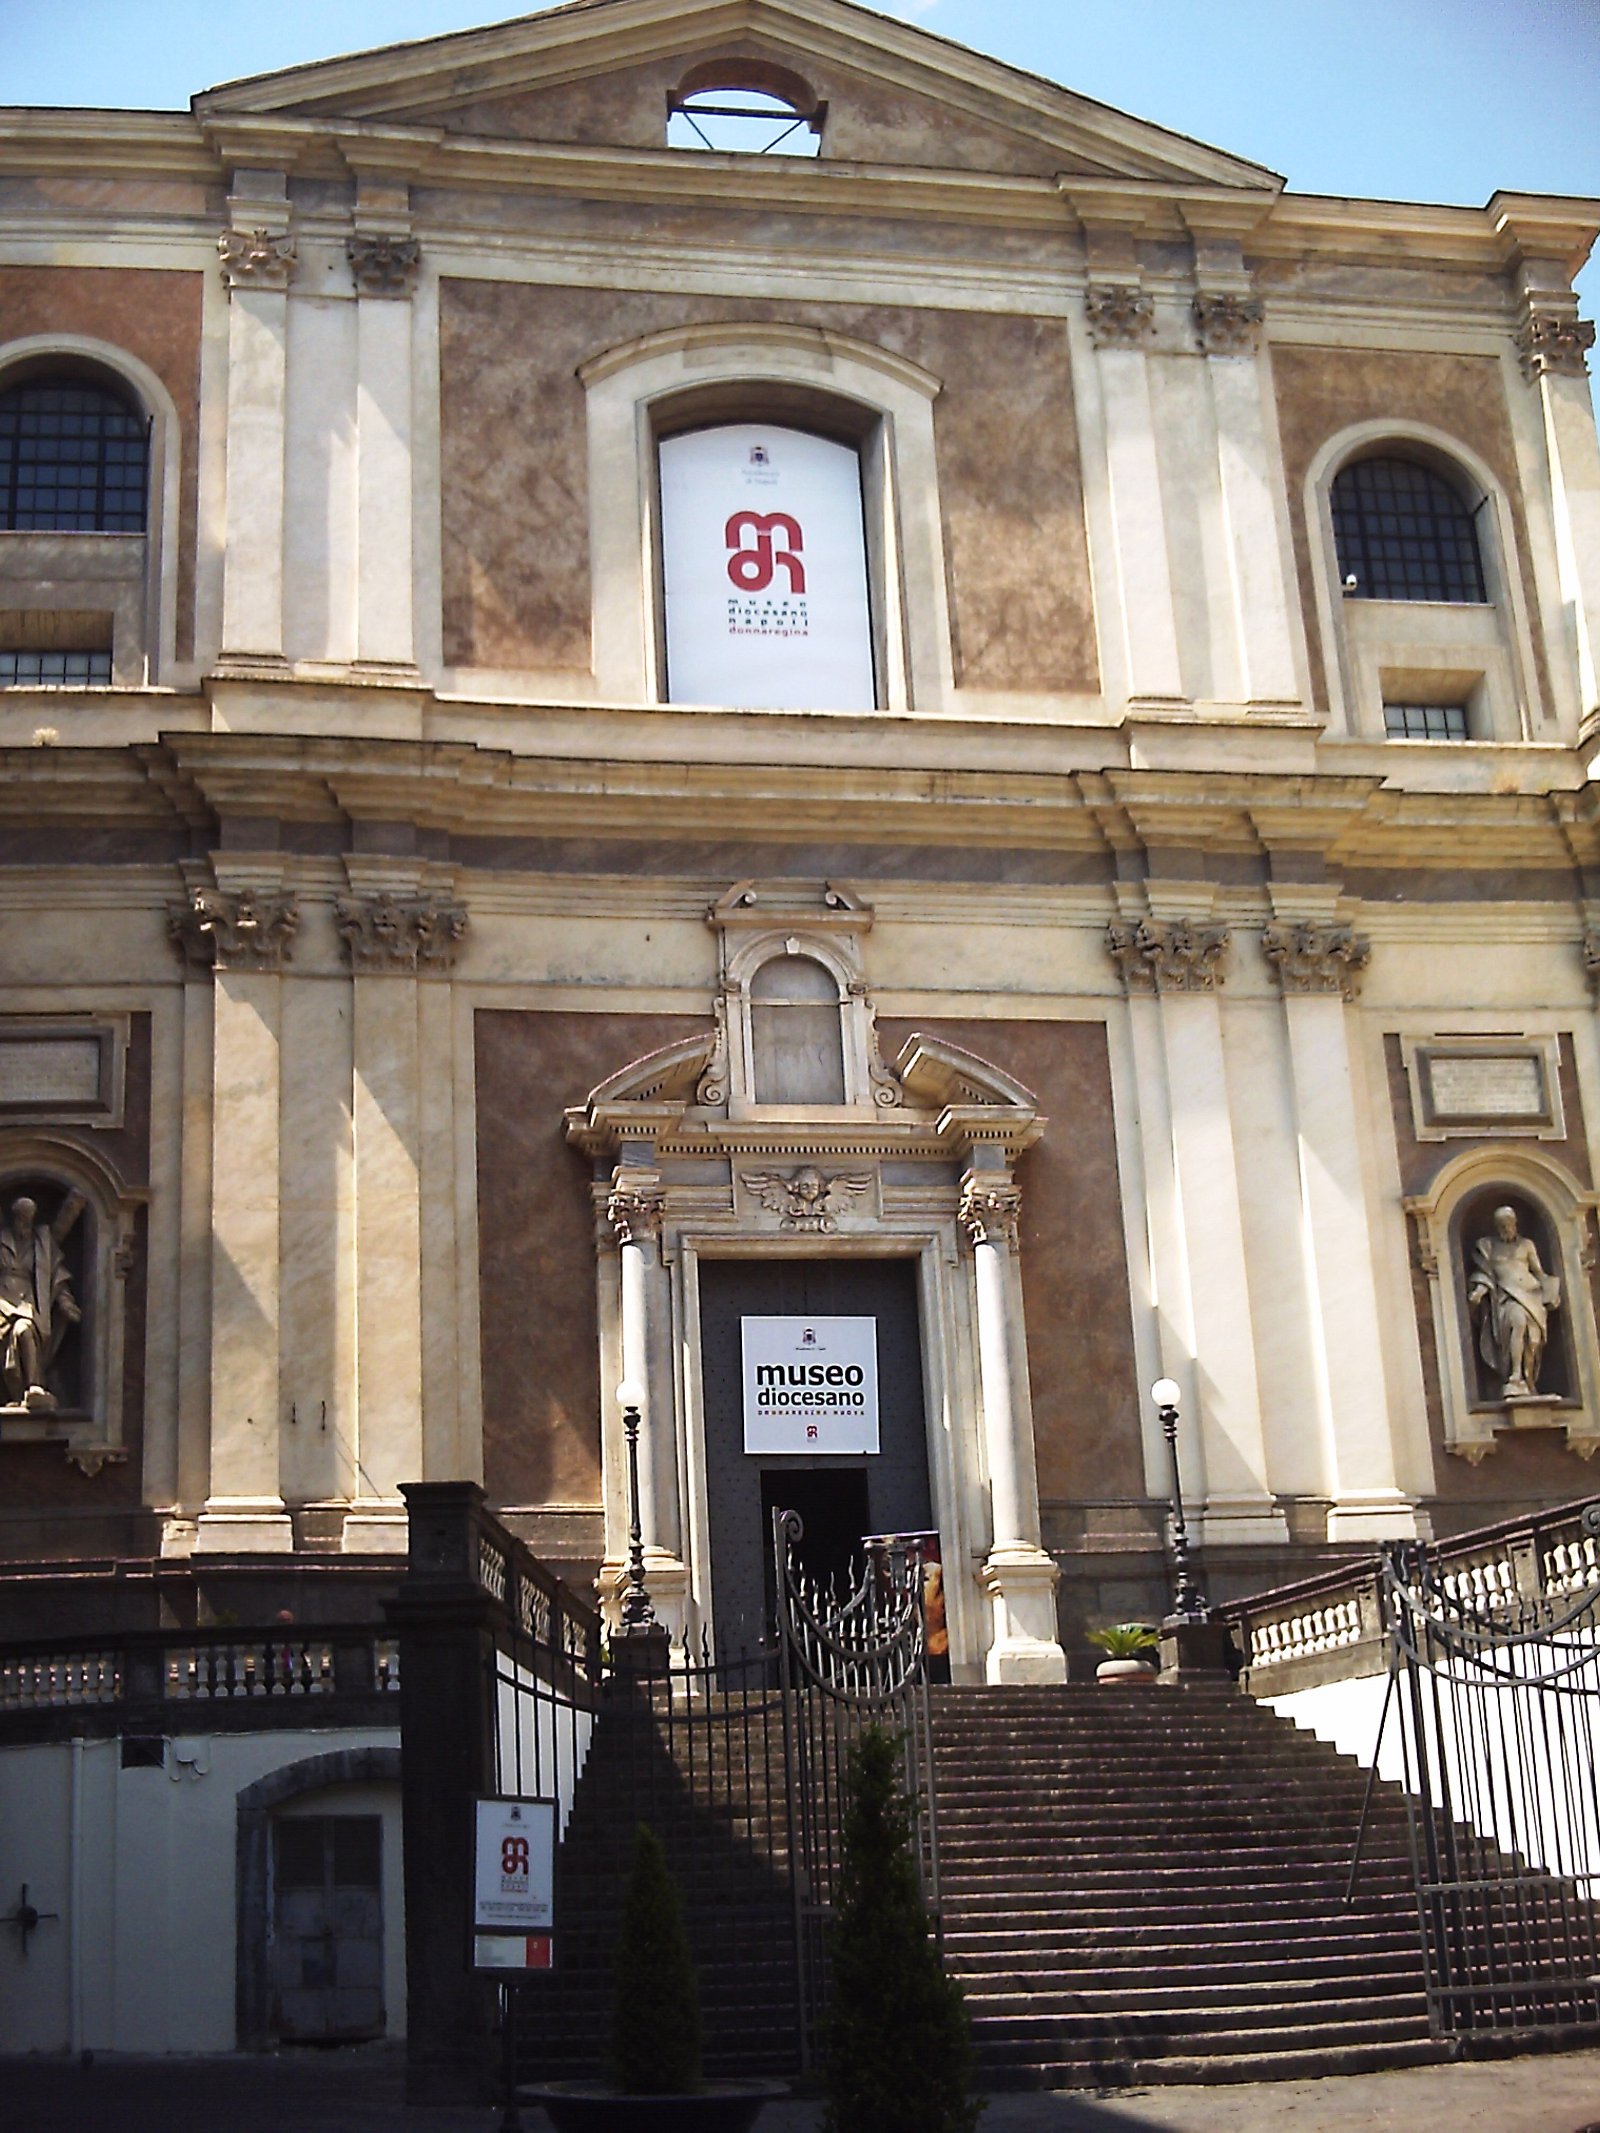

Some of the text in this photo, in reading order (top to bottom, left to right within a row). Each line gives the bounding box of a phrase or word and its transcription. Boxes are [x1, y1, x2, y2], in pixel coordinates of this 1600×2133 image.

[729, 607, 807, 616] diocesano
[729, 618, 808, 626] napoli
[729, 626, 808, 637] donnaregina
[757, 1365, 863, 1386] museo
[758, 1388, 864, 1406] diocesano
